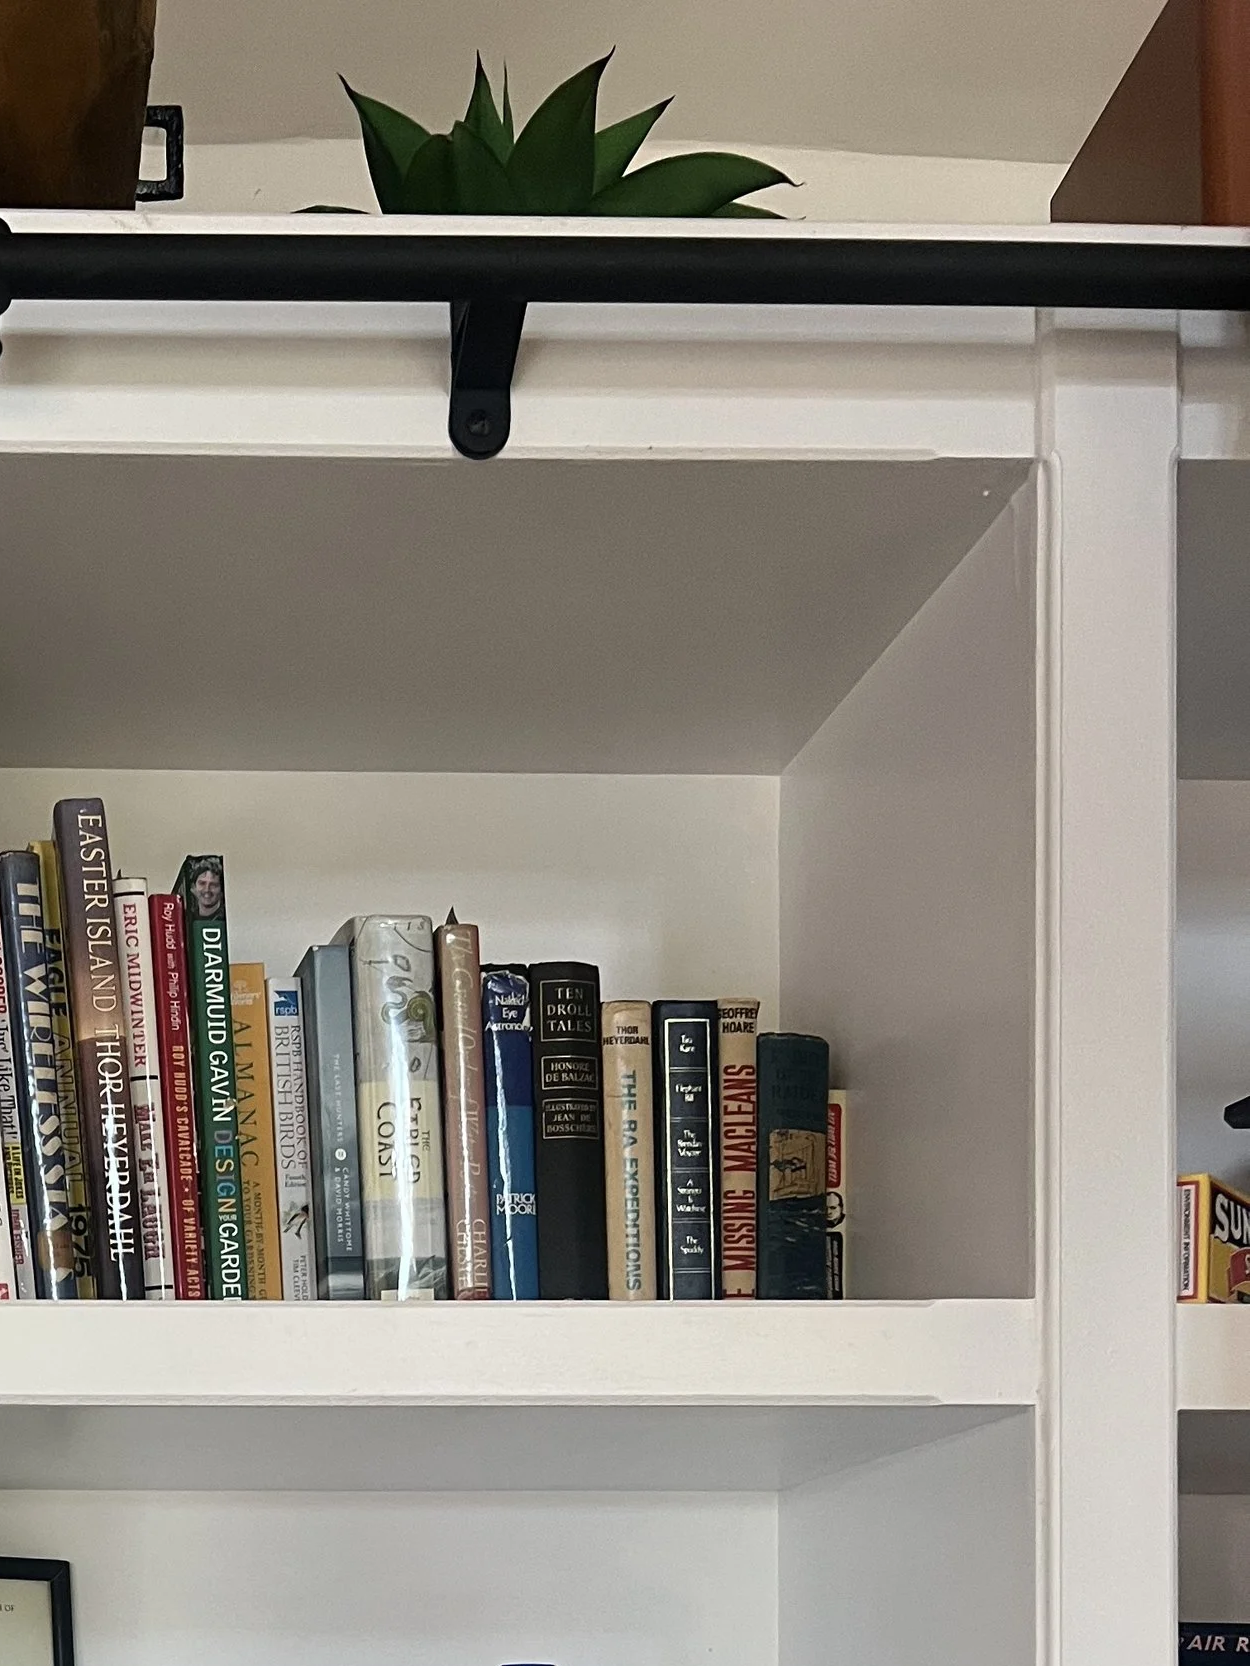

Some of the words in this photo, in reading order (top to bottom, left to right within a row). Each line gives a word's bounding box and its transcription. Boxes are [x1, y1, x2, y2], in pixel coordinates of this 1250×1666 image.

[77, 814, 109, 912] EASTER
[16, 878, 44, 953] THE
[122, 904, 140, 948] ERIC
[162, 902, 174, 922] Roy
[165, 924, 177, 950] Hudd
[86, 918, 117, 1012] ISLAND
[168, 972, 179, 998] Philip
[202, 928, 227, 1045] DIARMUID
[555, 987, 584, 1000] TEN
[126, 953, 147, 1068] MIDWINTER
[275, 1005, 299, 1016] rspb
[502, 1007, 518, 1019] Eye
[546, 1020, 592, 1033] TALES
[547, 1003, 592, 1017] DROLL
[722, 1021, 755, 1034] HOARE
[291, 1025, 303, 1057] RSPB
[602, 1036, 650, 1046] HEYERDAHL
[616, 1025, 639, 1035] THOR
[95, 1024, 123, 1098] THOR
[172, 1046, 186, 1067] ROY
[275, 1025, 293, 1105] BRITISH
[174, 1072, 189, 1113] HUDD'S
[209, 1051, 232, 1122] GAVIN
[234, 1020, 260, 1166] ALMANAC
[545, 1073, 560, 1083] DE
[621, 1070, 637, 1110] THE
[293, 1061, 307, 1145] HANDBOOK
[553, 1114, 575, 1123] JEAN
[723, 1064, 758, 1172] MACLEANS
[176, 1117, 193, 1180] CAVALCADE
[279, 1111, 297, 1170] BIRDS
[377, 1102, 398, 1180] COAST
[422, 1130, 431, 1151] THE
[622, 1119, 638, 1148] RA
[214, 1130, 237, 1213] DESIGN
[297, 1150, 308, 1170] OF
[101, 1103, 135, 1262] HEYERDAHL
[335, 1177, 343, 1204] DAVID
[342, 1167, 351, 1199] CANDY
[182, 1199, 195, 1213] OF
[623, 1157, 641, 1291] EXPEDITIONS
[68, 1203, 91, 1277] 1975
[183, 1218, 199, 1264] VARIETY
[336, 1207, 345, 1243] MORRIS
[722, 1188, 756, 1272] MISSING
[186, 1269, 201, 1298] ACTS
[4, 1604, 15, 1612] OF
